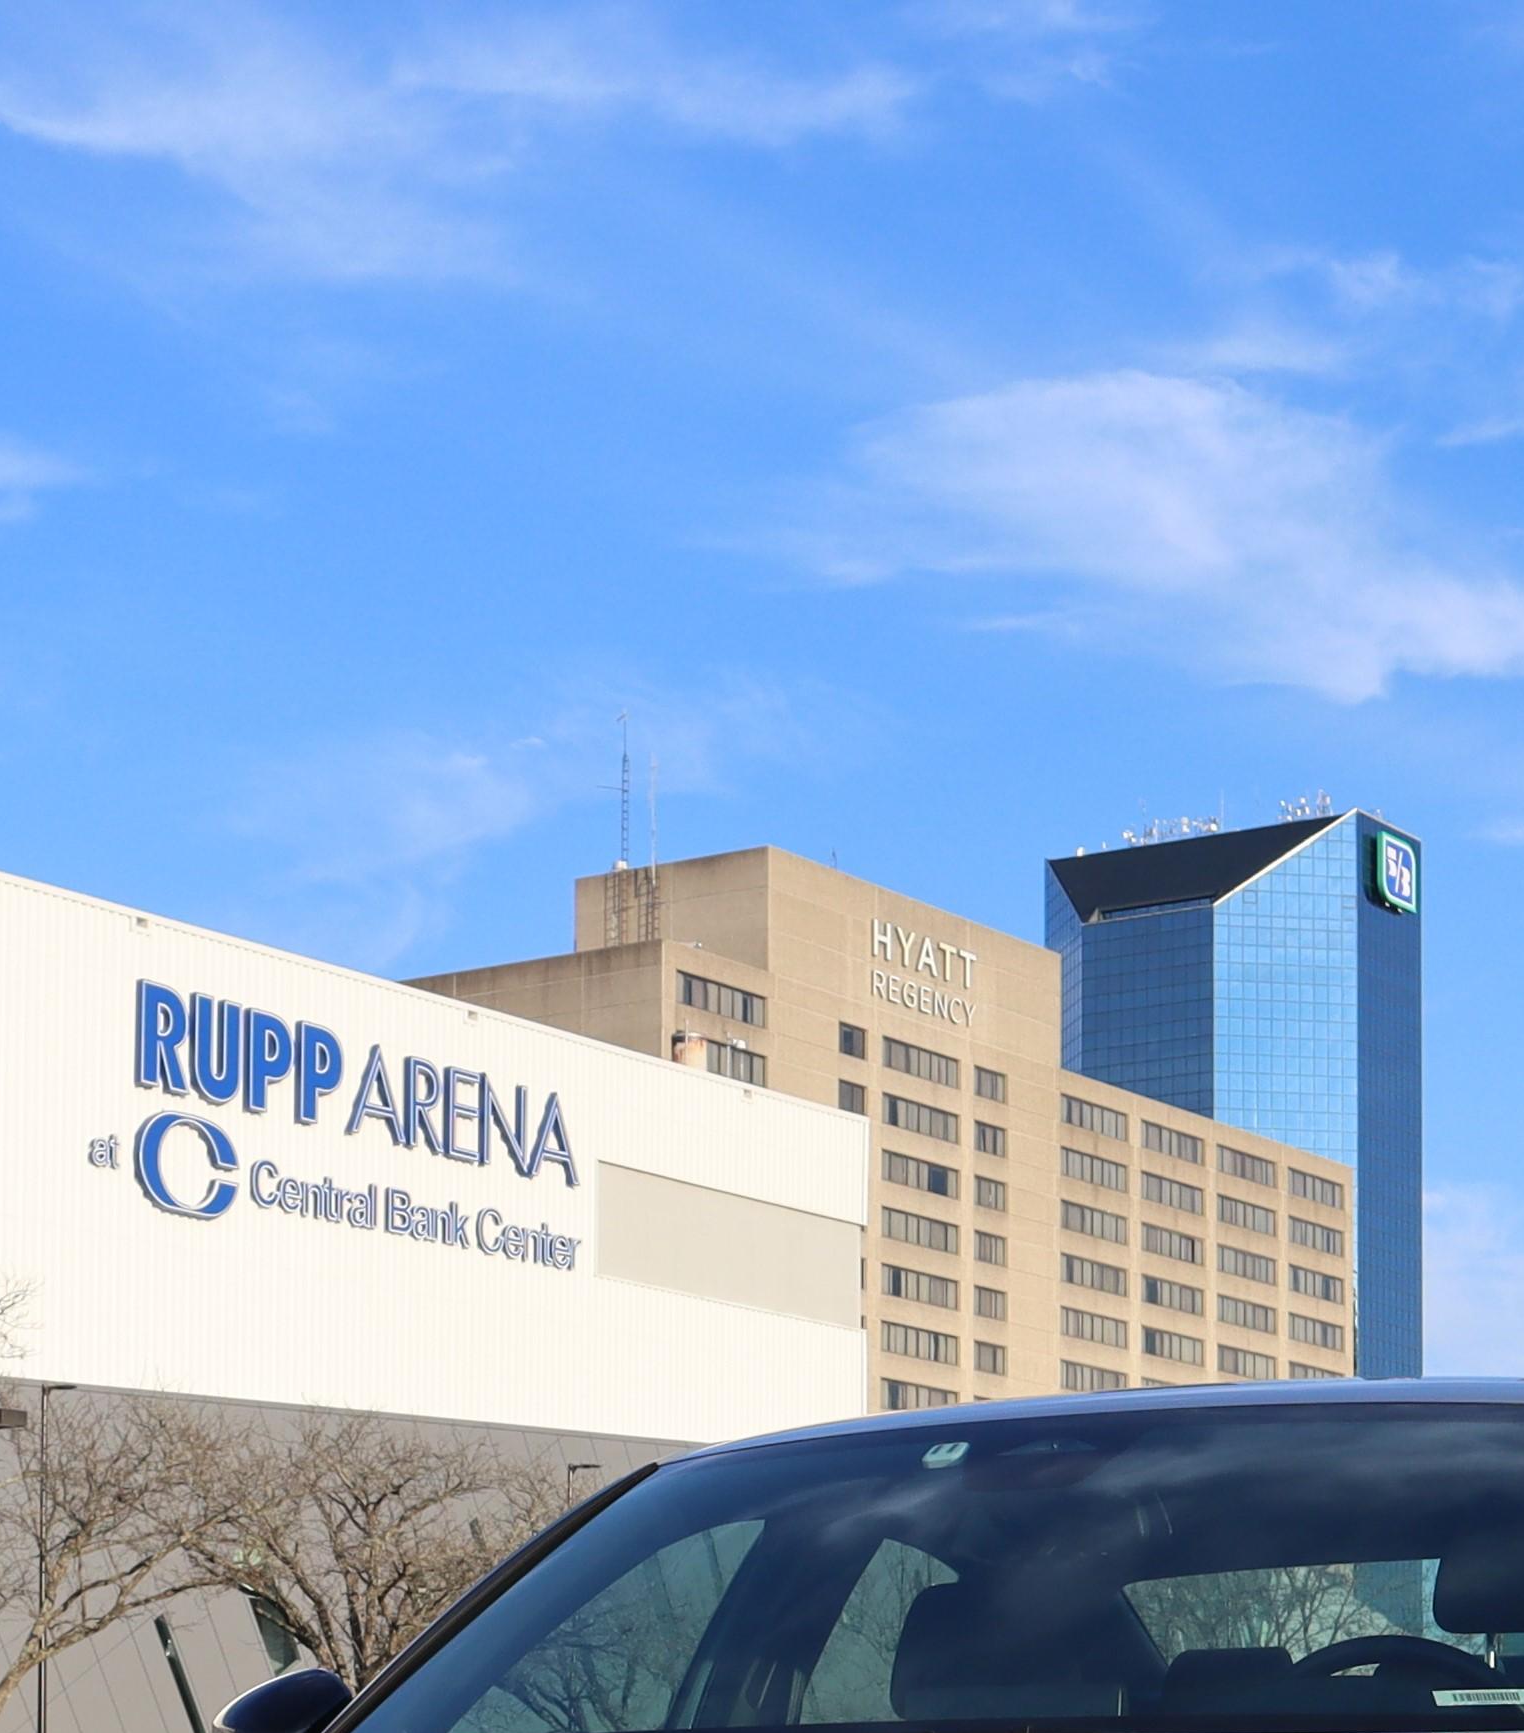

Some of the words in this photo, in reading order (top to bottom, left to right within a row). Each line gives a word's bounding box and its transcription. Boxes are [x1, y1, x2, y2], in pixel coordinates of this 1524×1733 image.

[871, 918, 977, 989] HYATT
[871, 969, 977, 1027] REGENCY
[134, 978, 344, 1124] RUPP
[344, 1043, 580, 1187] ARENA
[88, 1134, 120, 1170] at
[250, 1159, 377, 1229] Central
[383, 1186, 470, 1249] Bank
[475, 1207, 581, 1271] Center
